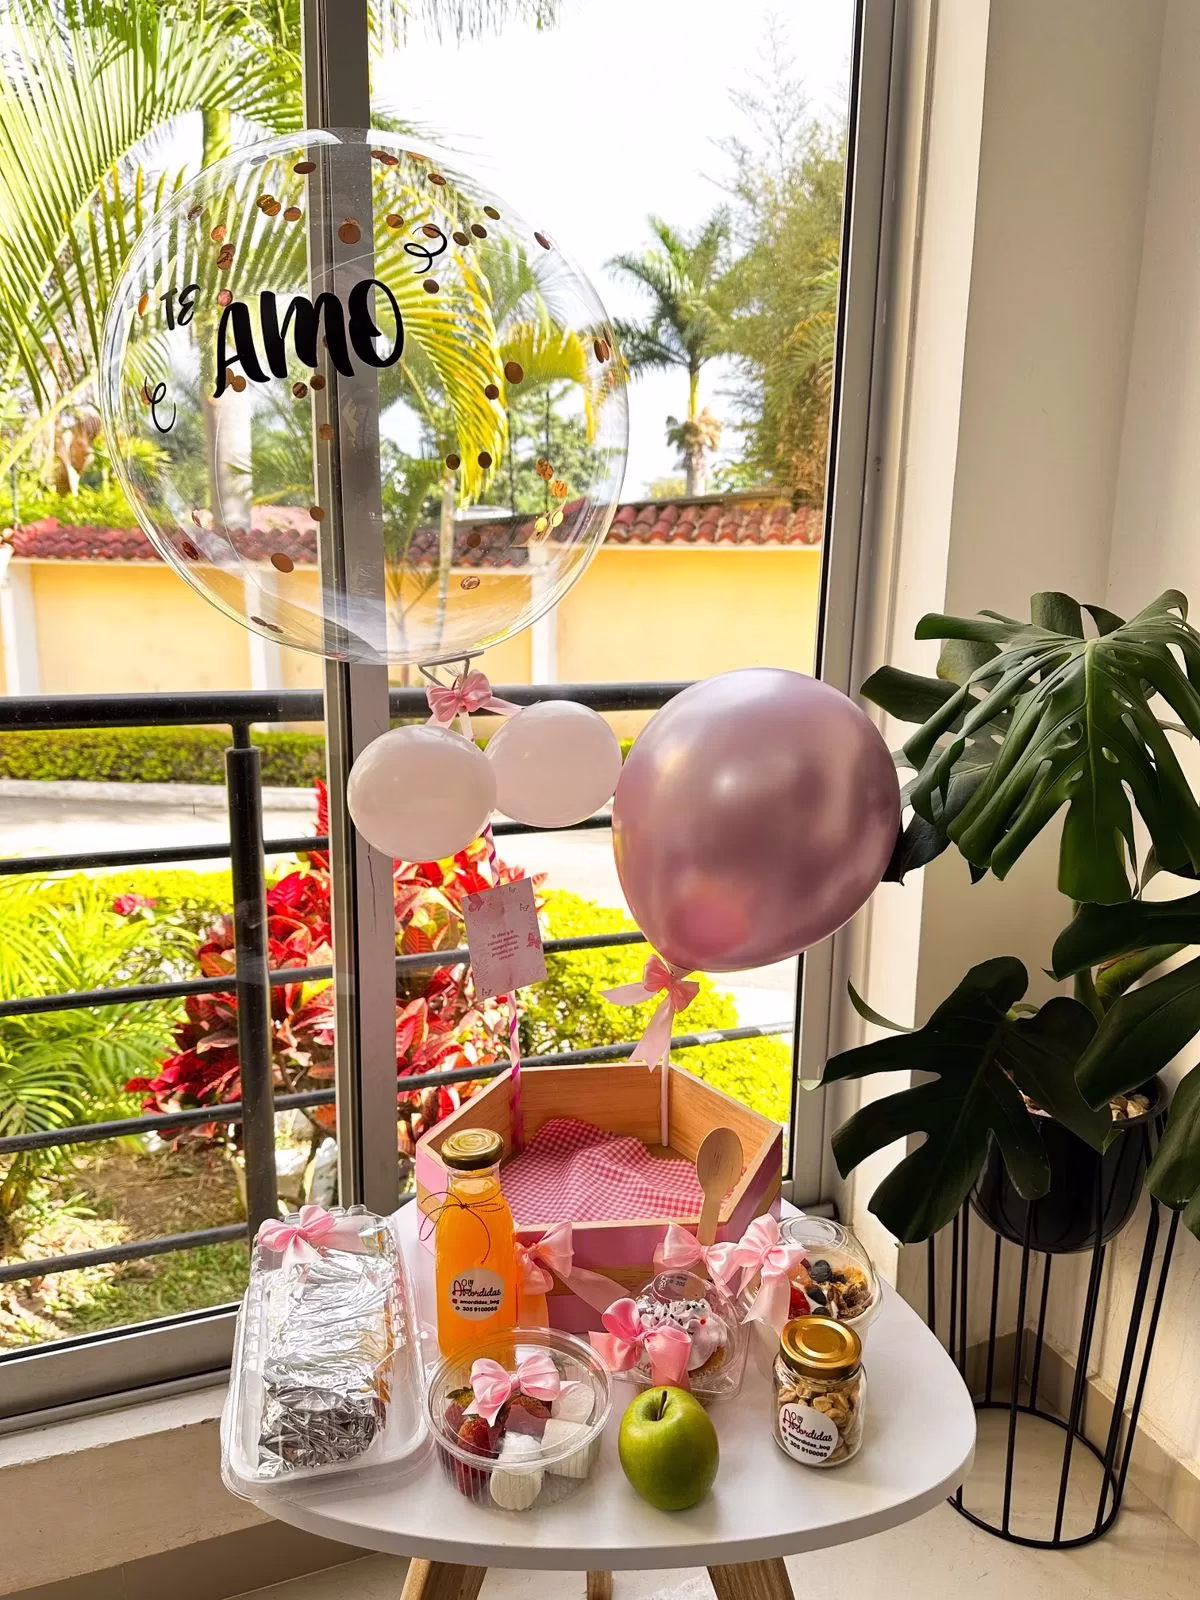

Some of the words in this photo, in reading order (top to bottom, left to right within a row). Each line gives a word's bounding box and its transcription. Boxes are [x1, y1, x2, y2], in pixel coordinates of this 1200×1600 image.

[159, 283, 201, 331] TE
[212, 279, 405, 399] AMO
[789, 1440, 801, 1450] 305
[801, 1445, 828, 1458] 9100065
